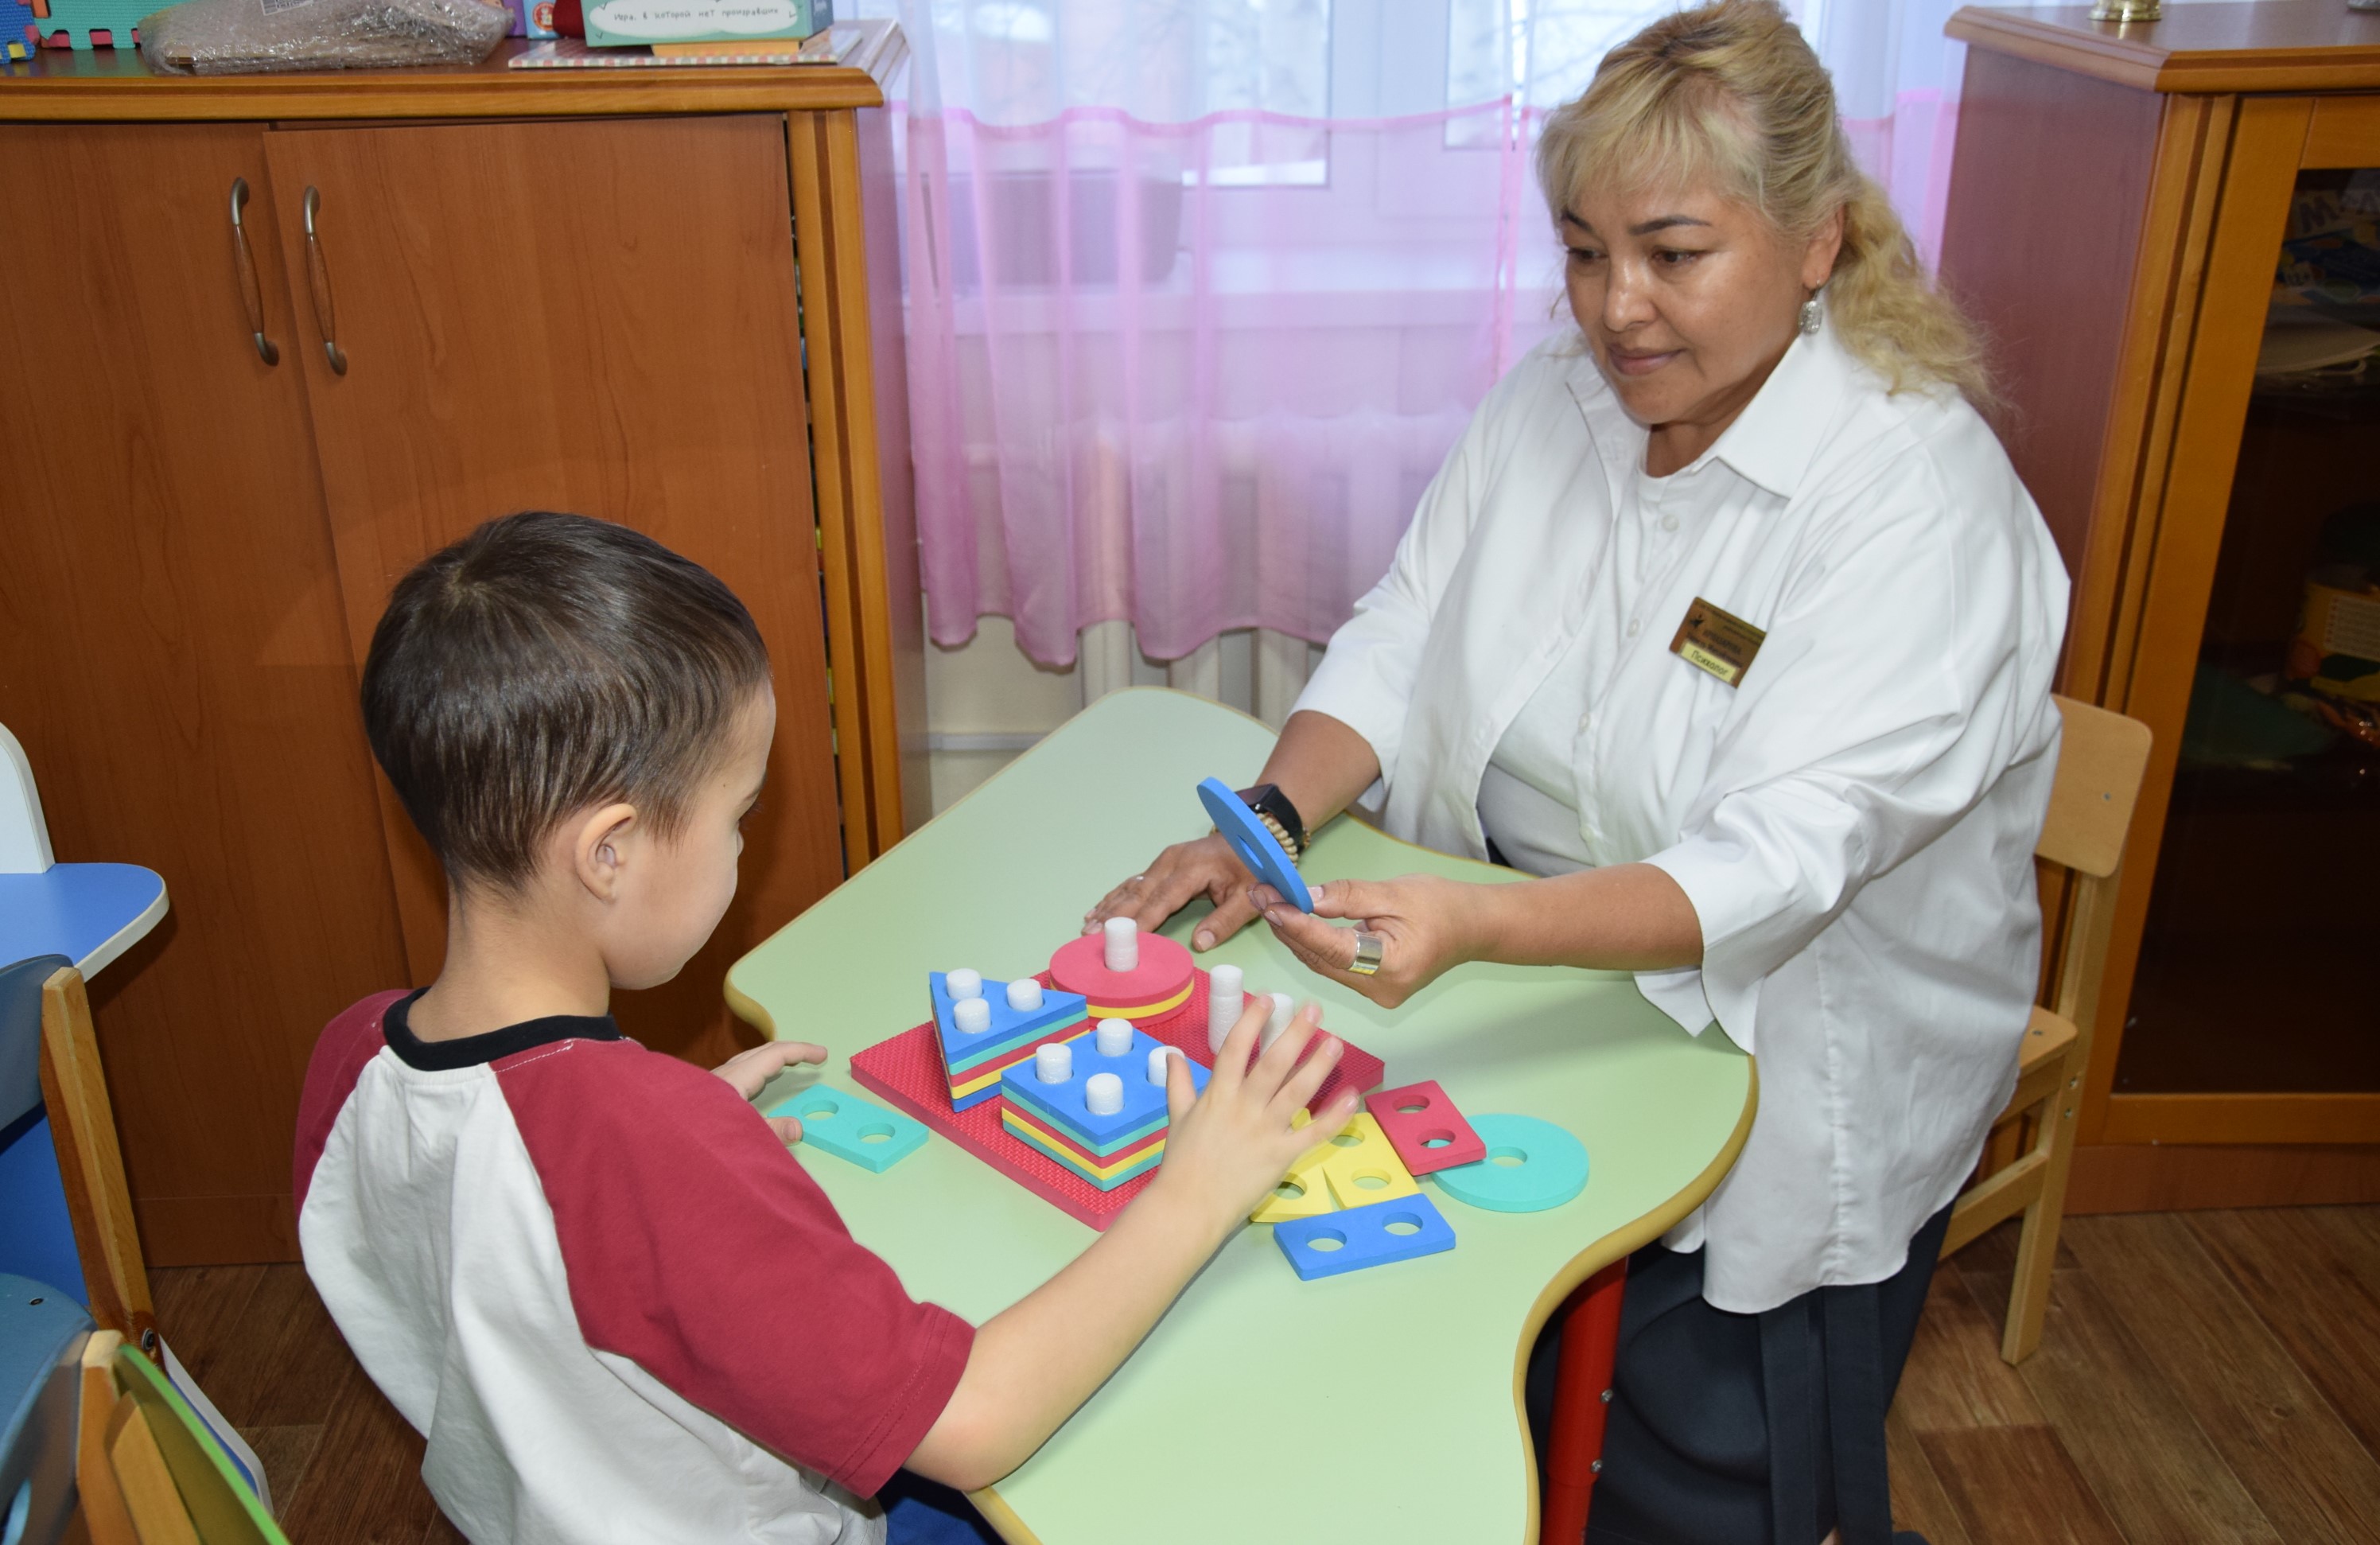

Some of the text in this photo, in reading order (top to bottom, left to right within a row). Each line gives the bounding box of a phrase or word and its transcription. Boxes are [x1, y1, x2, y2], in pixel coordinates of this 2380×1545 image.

[655, 10, 691, 20] которой
[698, 9, 715, 18] нет
[721, 7, 779, 18] проигравших
[1690, 649, 1729, 676] Психолог
